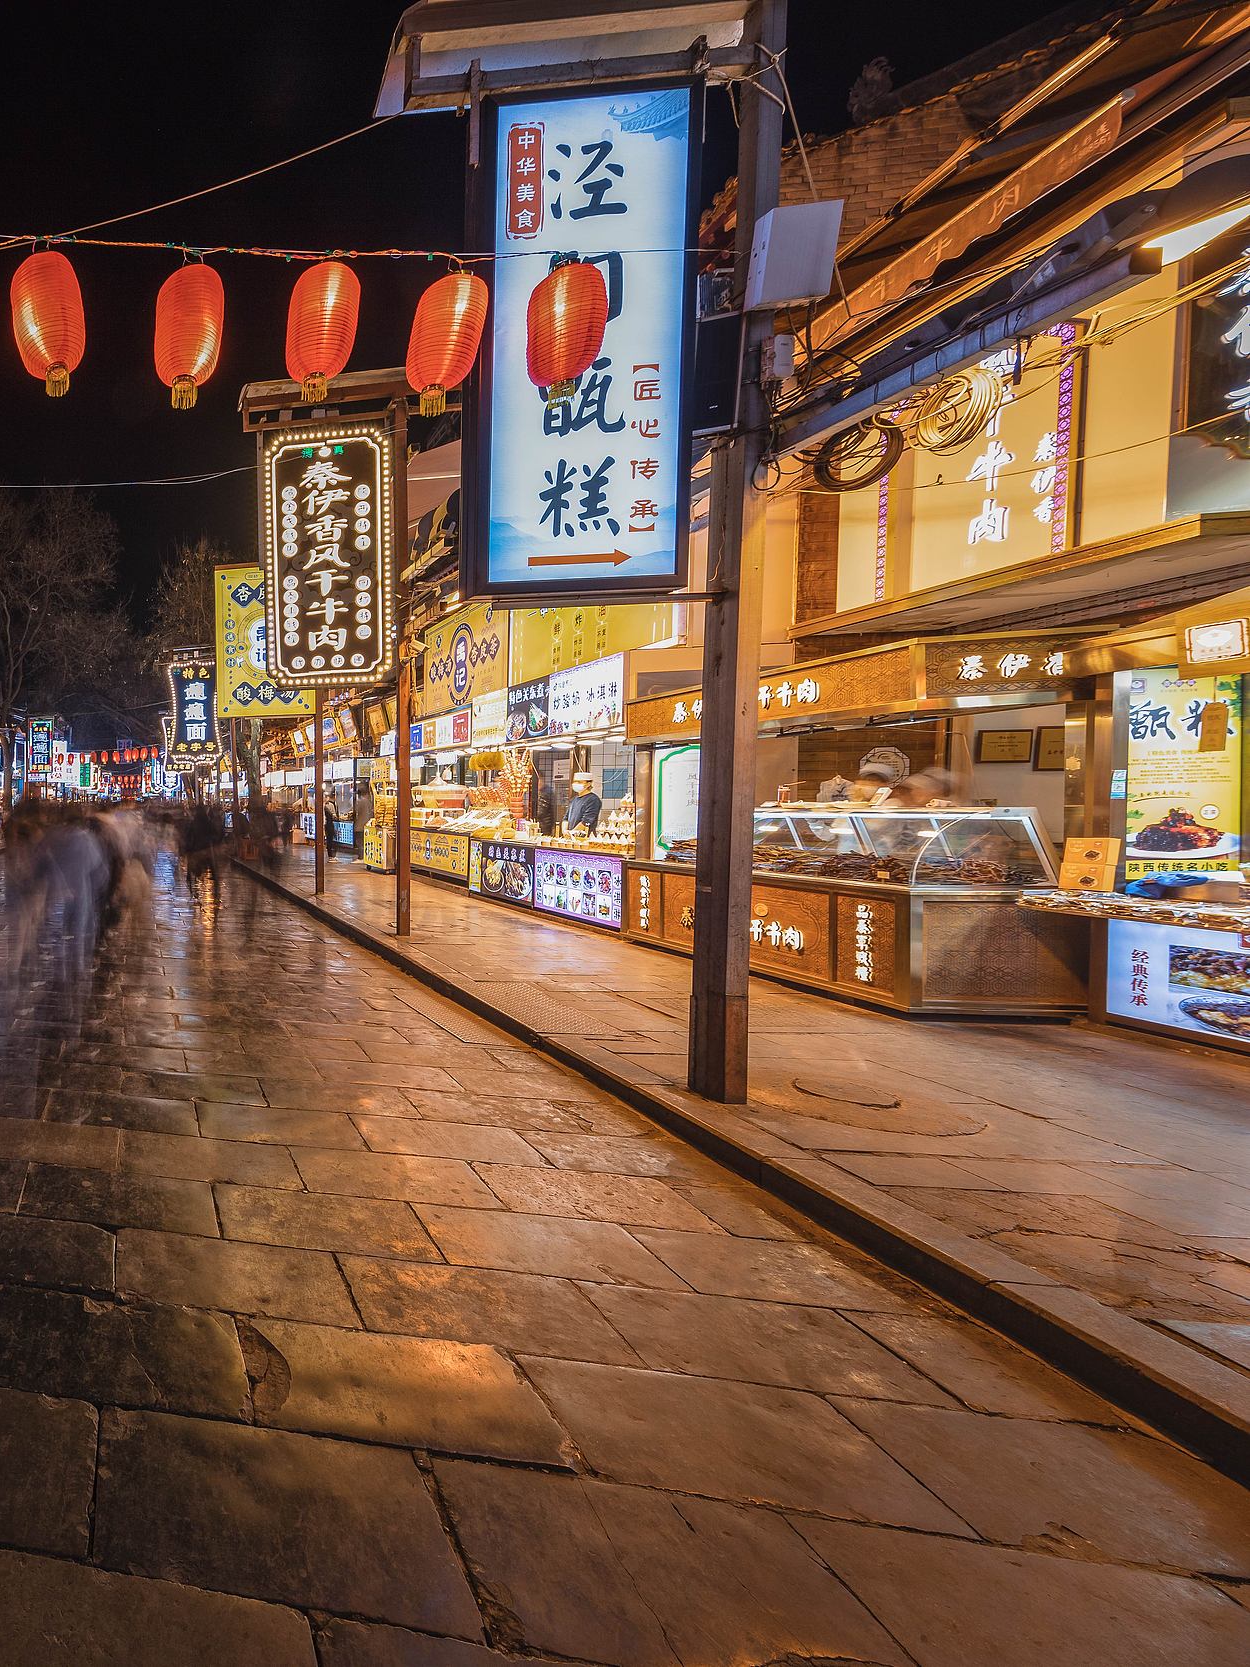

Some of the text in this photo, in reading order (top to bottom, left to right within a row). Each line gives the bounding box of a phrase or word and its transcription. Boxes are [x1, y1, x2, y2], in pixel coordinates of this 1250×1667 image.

[514, 131, 536, 230] 中华美食
[538, 139, 629, 538] 泾甑糕
[182, 667, 211, 679] 特色
[586, 681, 618, 702] 冰淇淋
[176, 742, 217, 752] 老字号
[1128, 862, 1229, 873] 陕西传统名小吃
[1130, 949, 1150, 1007] 经典传承
